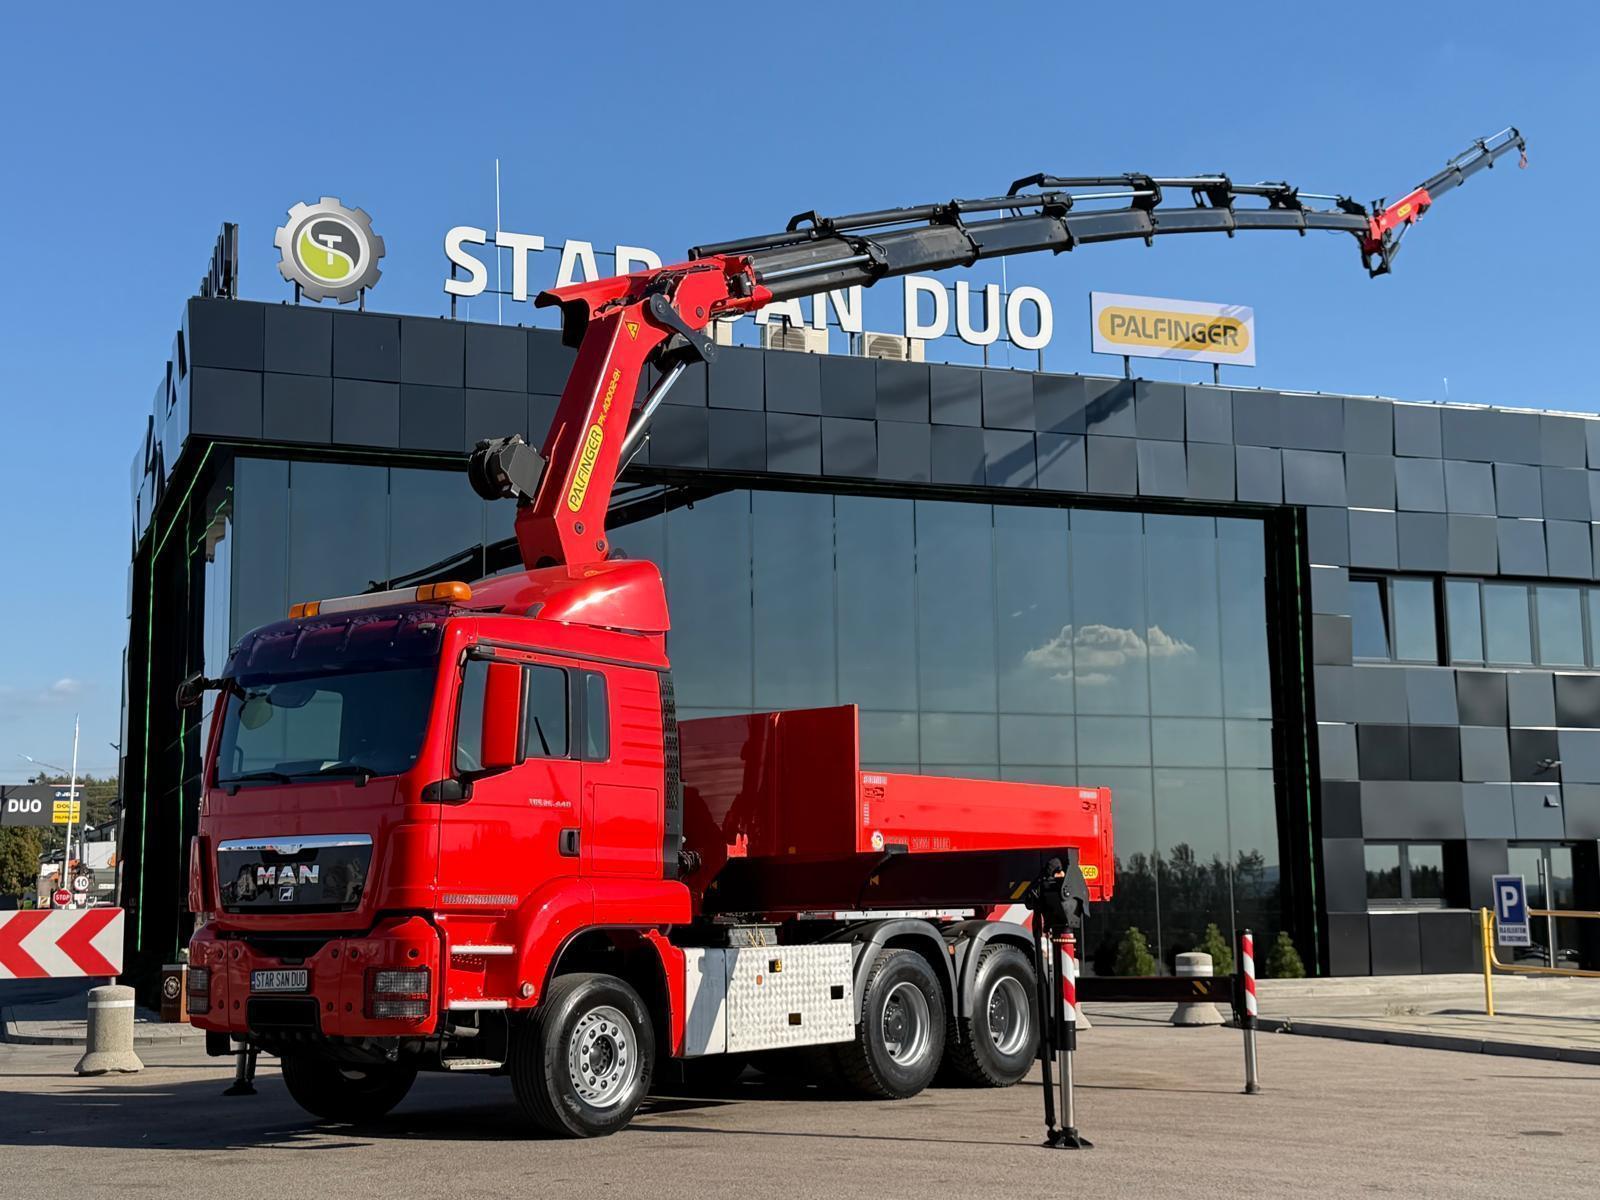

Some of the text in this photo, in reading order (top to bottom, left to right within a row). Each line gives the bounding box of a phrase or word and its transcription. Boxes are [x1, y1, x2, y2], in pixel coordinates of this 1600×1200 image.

[718, 285, 863, 333] AN
[904, 275, 1053, 350] DUO
[1110, 313, 1239, 346] PALFINGER
[569, 429, 602, 508] PALFINGER
[597, 411, 607, 427] PK
[8, 798, 42, 813] DUO
[77, 878, 87, 887] 10
[256, 864, 320, 885] MAN
[1500, 885, 1519, 918] P
[256, 971, 306, 987] STAR SAN DUO
